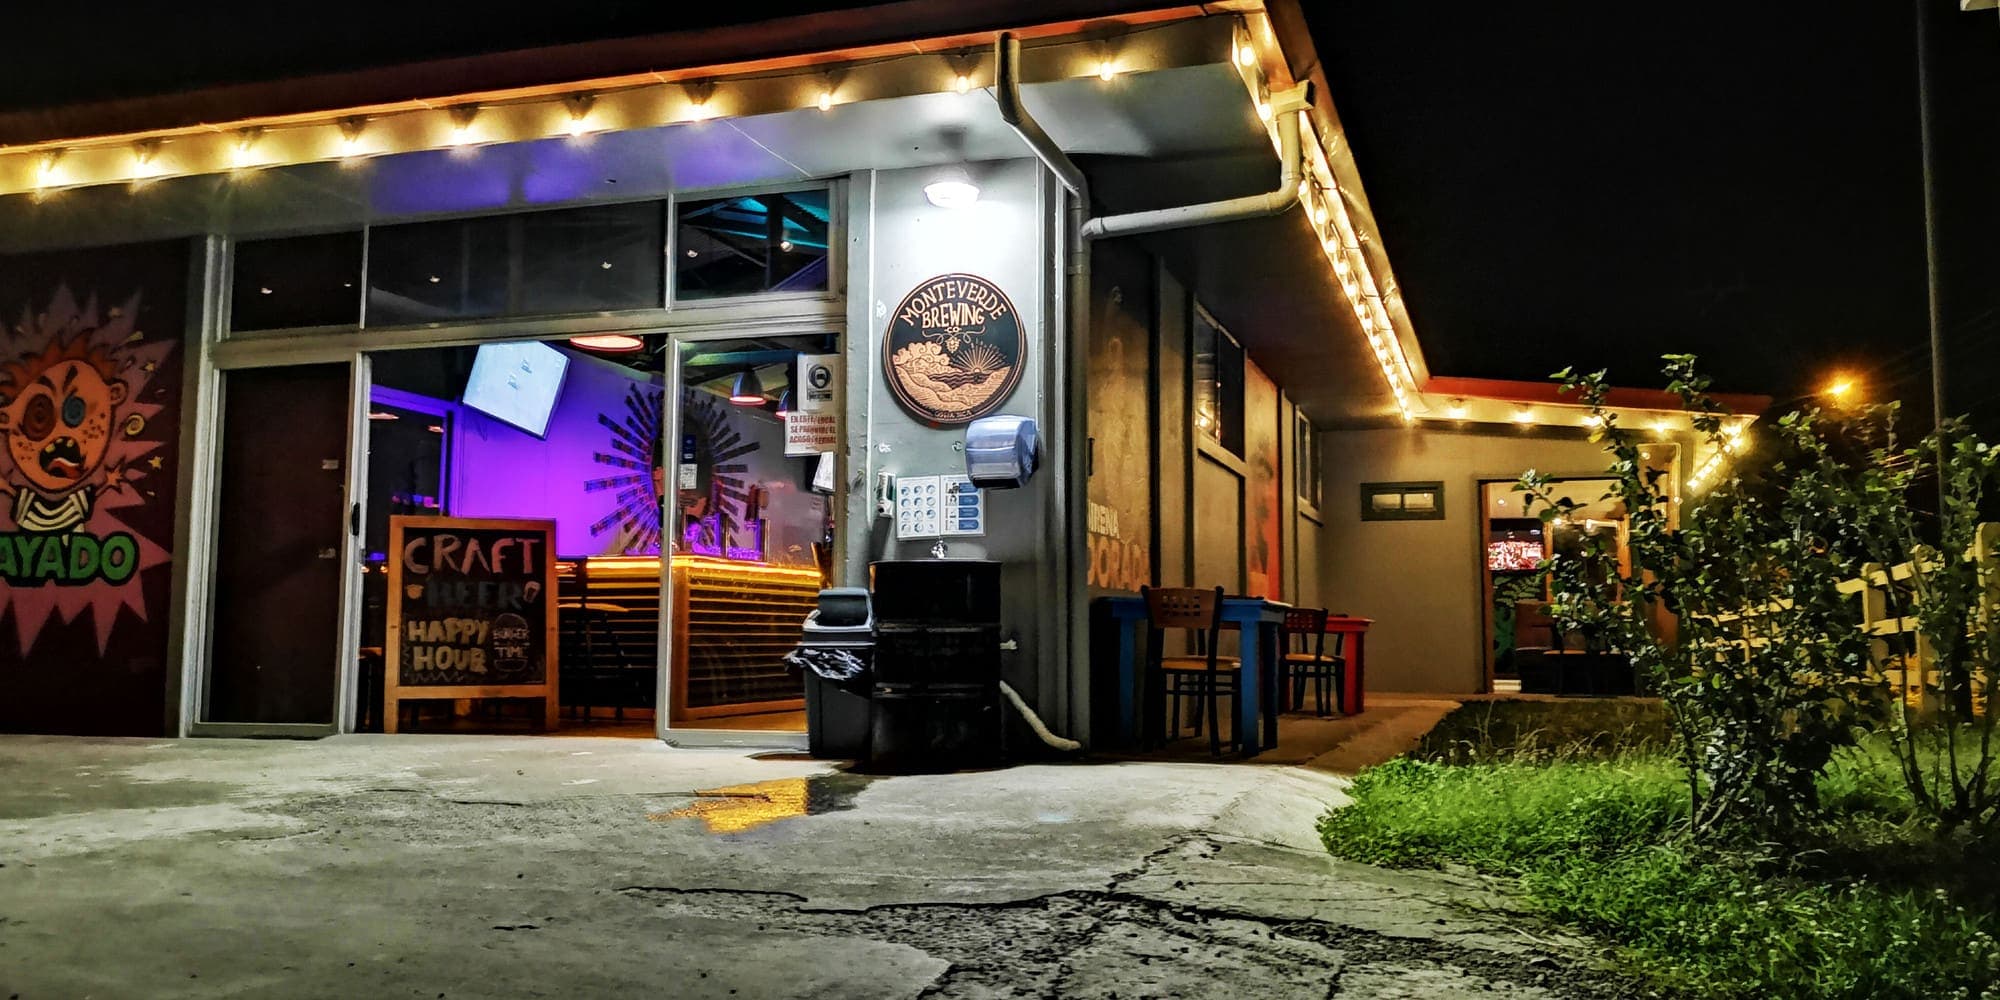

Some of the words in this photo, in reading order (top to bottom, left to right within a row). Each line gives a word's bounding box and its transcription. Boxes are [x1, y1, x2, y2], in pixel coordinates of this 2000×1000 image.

[900, 280, 1007, 326] MONTEVERDE
[922, 302, 985, 329] BREWING
[1088, 501, 1120, 539] IRENA
[404, 533, 540, 575] CRAFT
[428, 579, 522, 611] BEER
[408, 617, 490, 645] HAPPY
[413, 645, 488, 674] HOUR
